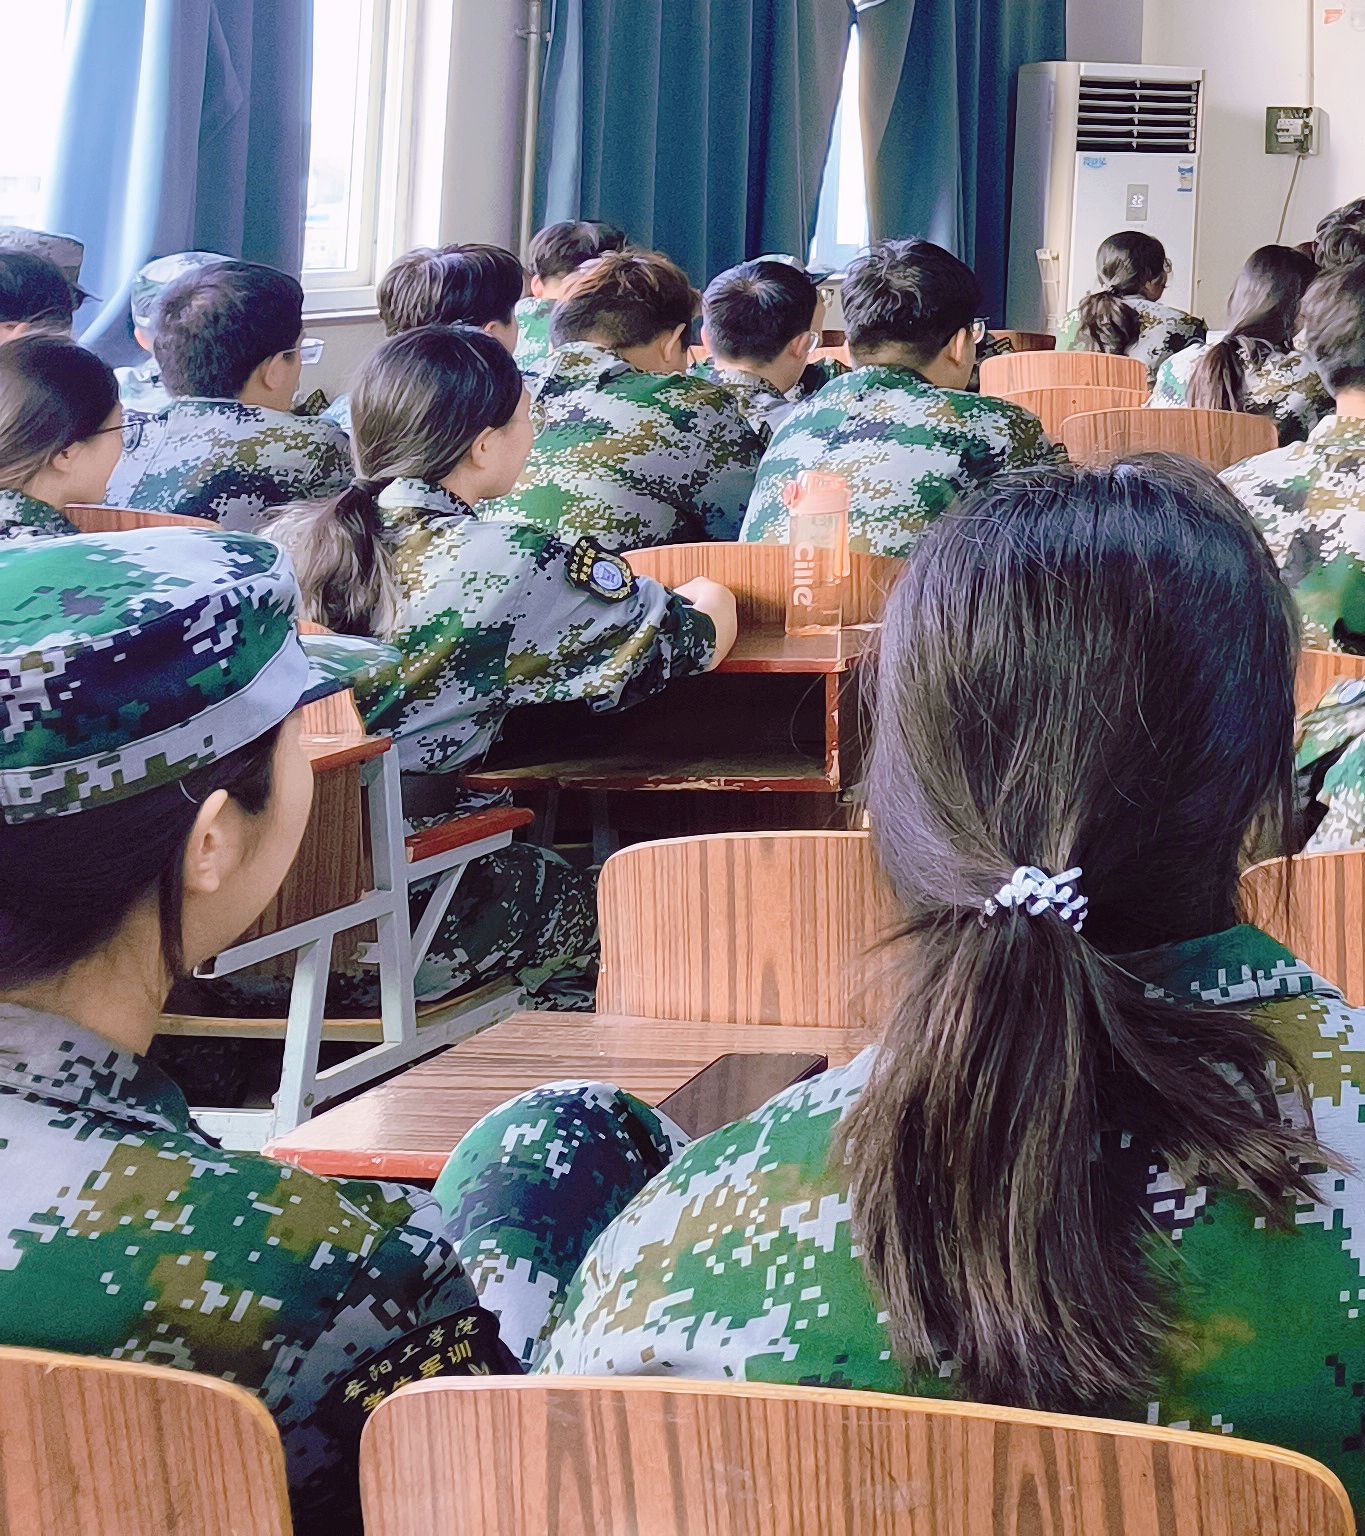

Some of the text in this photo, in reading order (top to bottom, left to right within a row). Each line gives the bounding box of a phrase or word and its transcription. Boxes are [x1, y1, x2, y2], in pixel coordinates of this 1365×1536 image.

[342, 1316, 480, 1404] 安阳工学院
